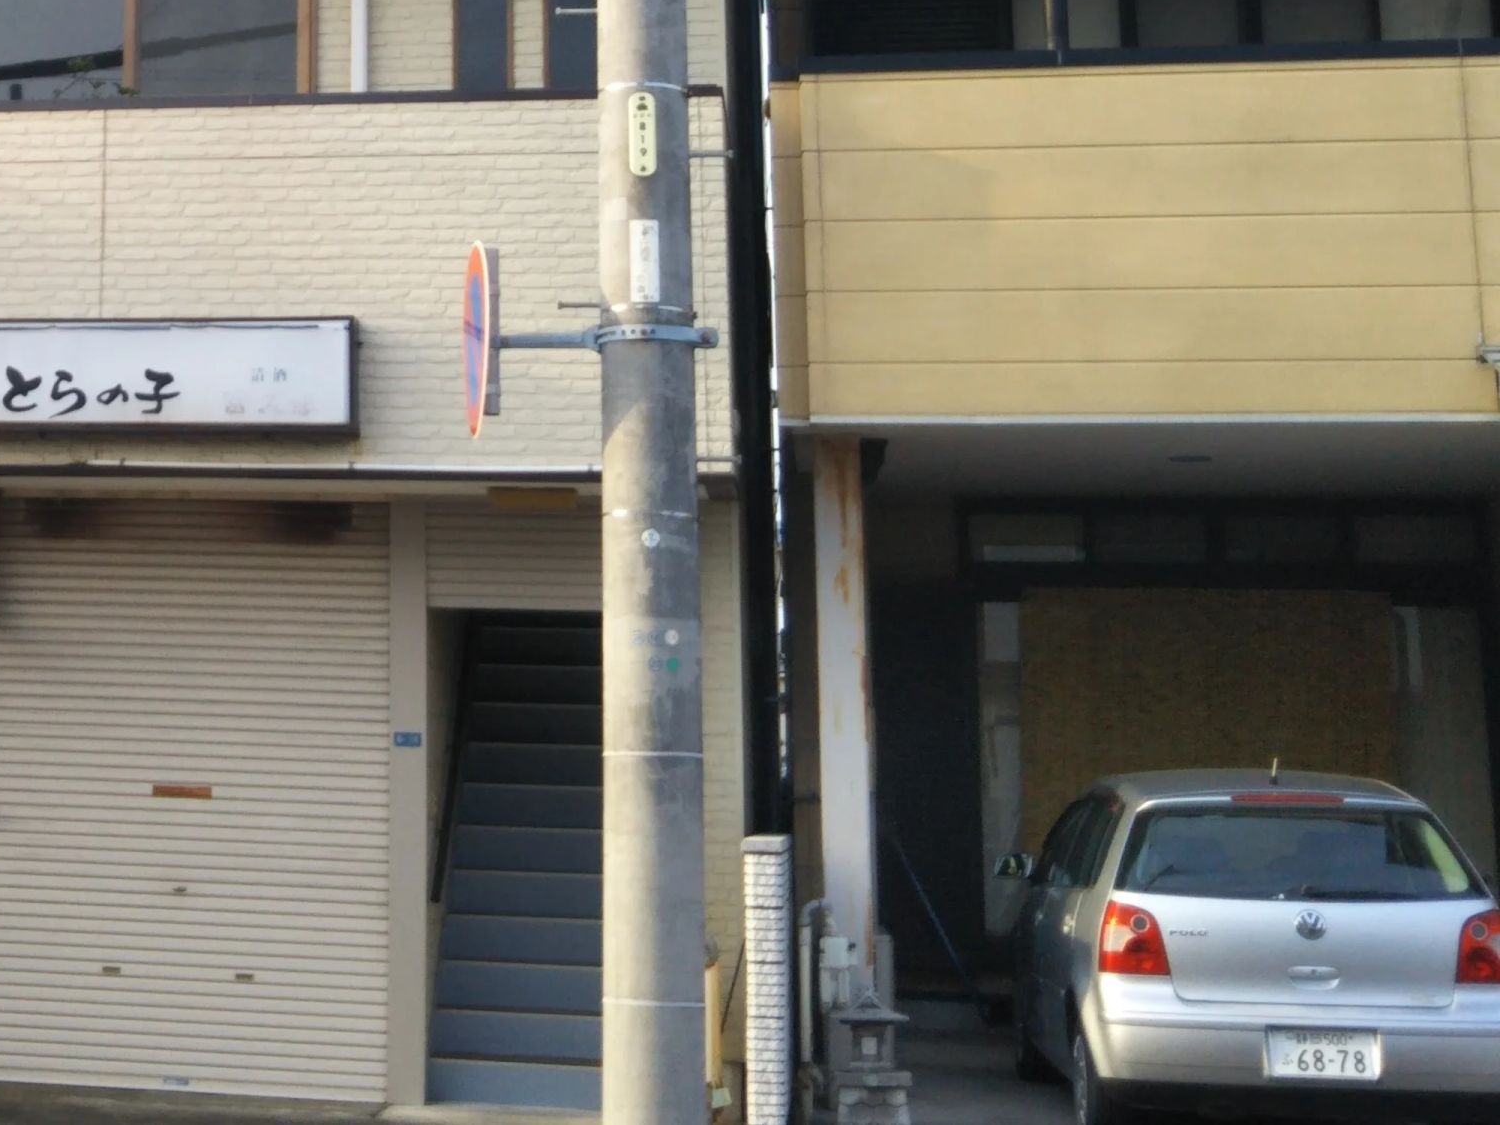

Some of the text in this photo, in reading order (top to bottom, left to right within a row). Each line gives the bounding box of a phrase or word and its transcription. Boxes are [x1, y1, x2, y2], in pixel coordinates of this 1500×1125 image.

[2, 365, 181, 419] とらの子
[1297, 1049, 1367, 1073] 68-78
